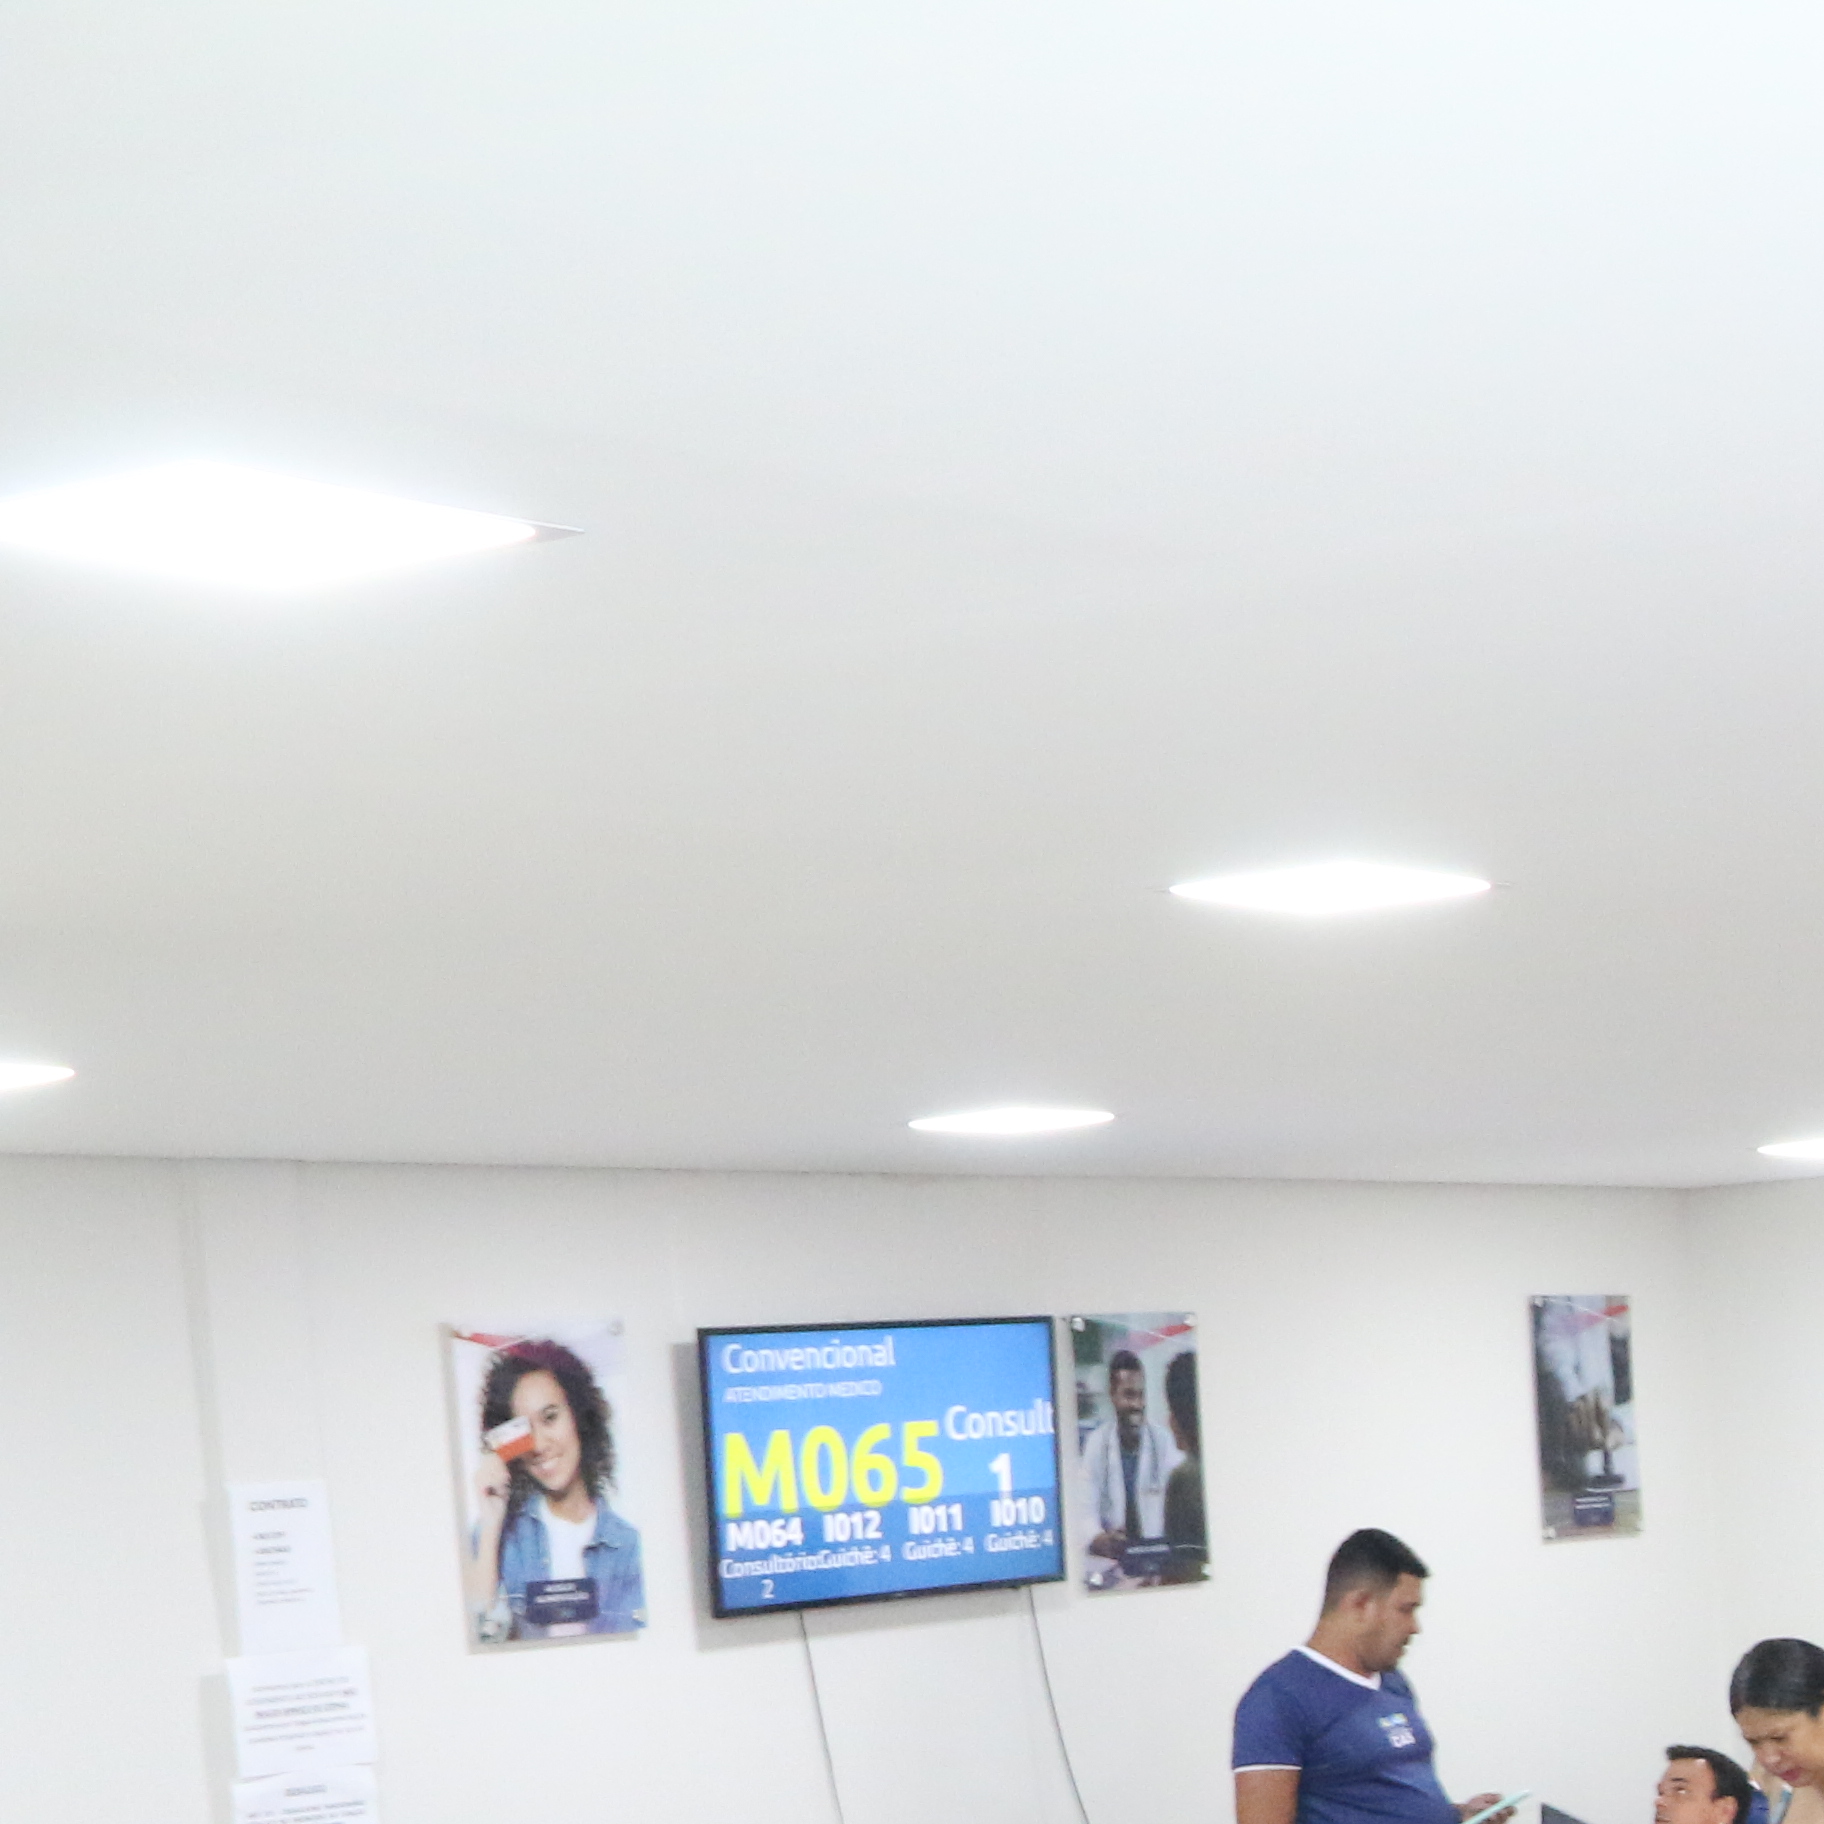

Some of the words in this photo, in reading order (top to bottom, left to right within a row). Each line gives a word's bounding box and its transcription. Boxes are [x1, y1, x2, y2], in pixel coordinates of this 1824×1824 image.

[722, 1335, 896, 1374] Convencional
[724, 1420, 943, 1518] M065
[989, 1453, 1012, 1500] 1
[726, 1517, 804, 1551] M064
[760, 1579, 774, 1599] 2
